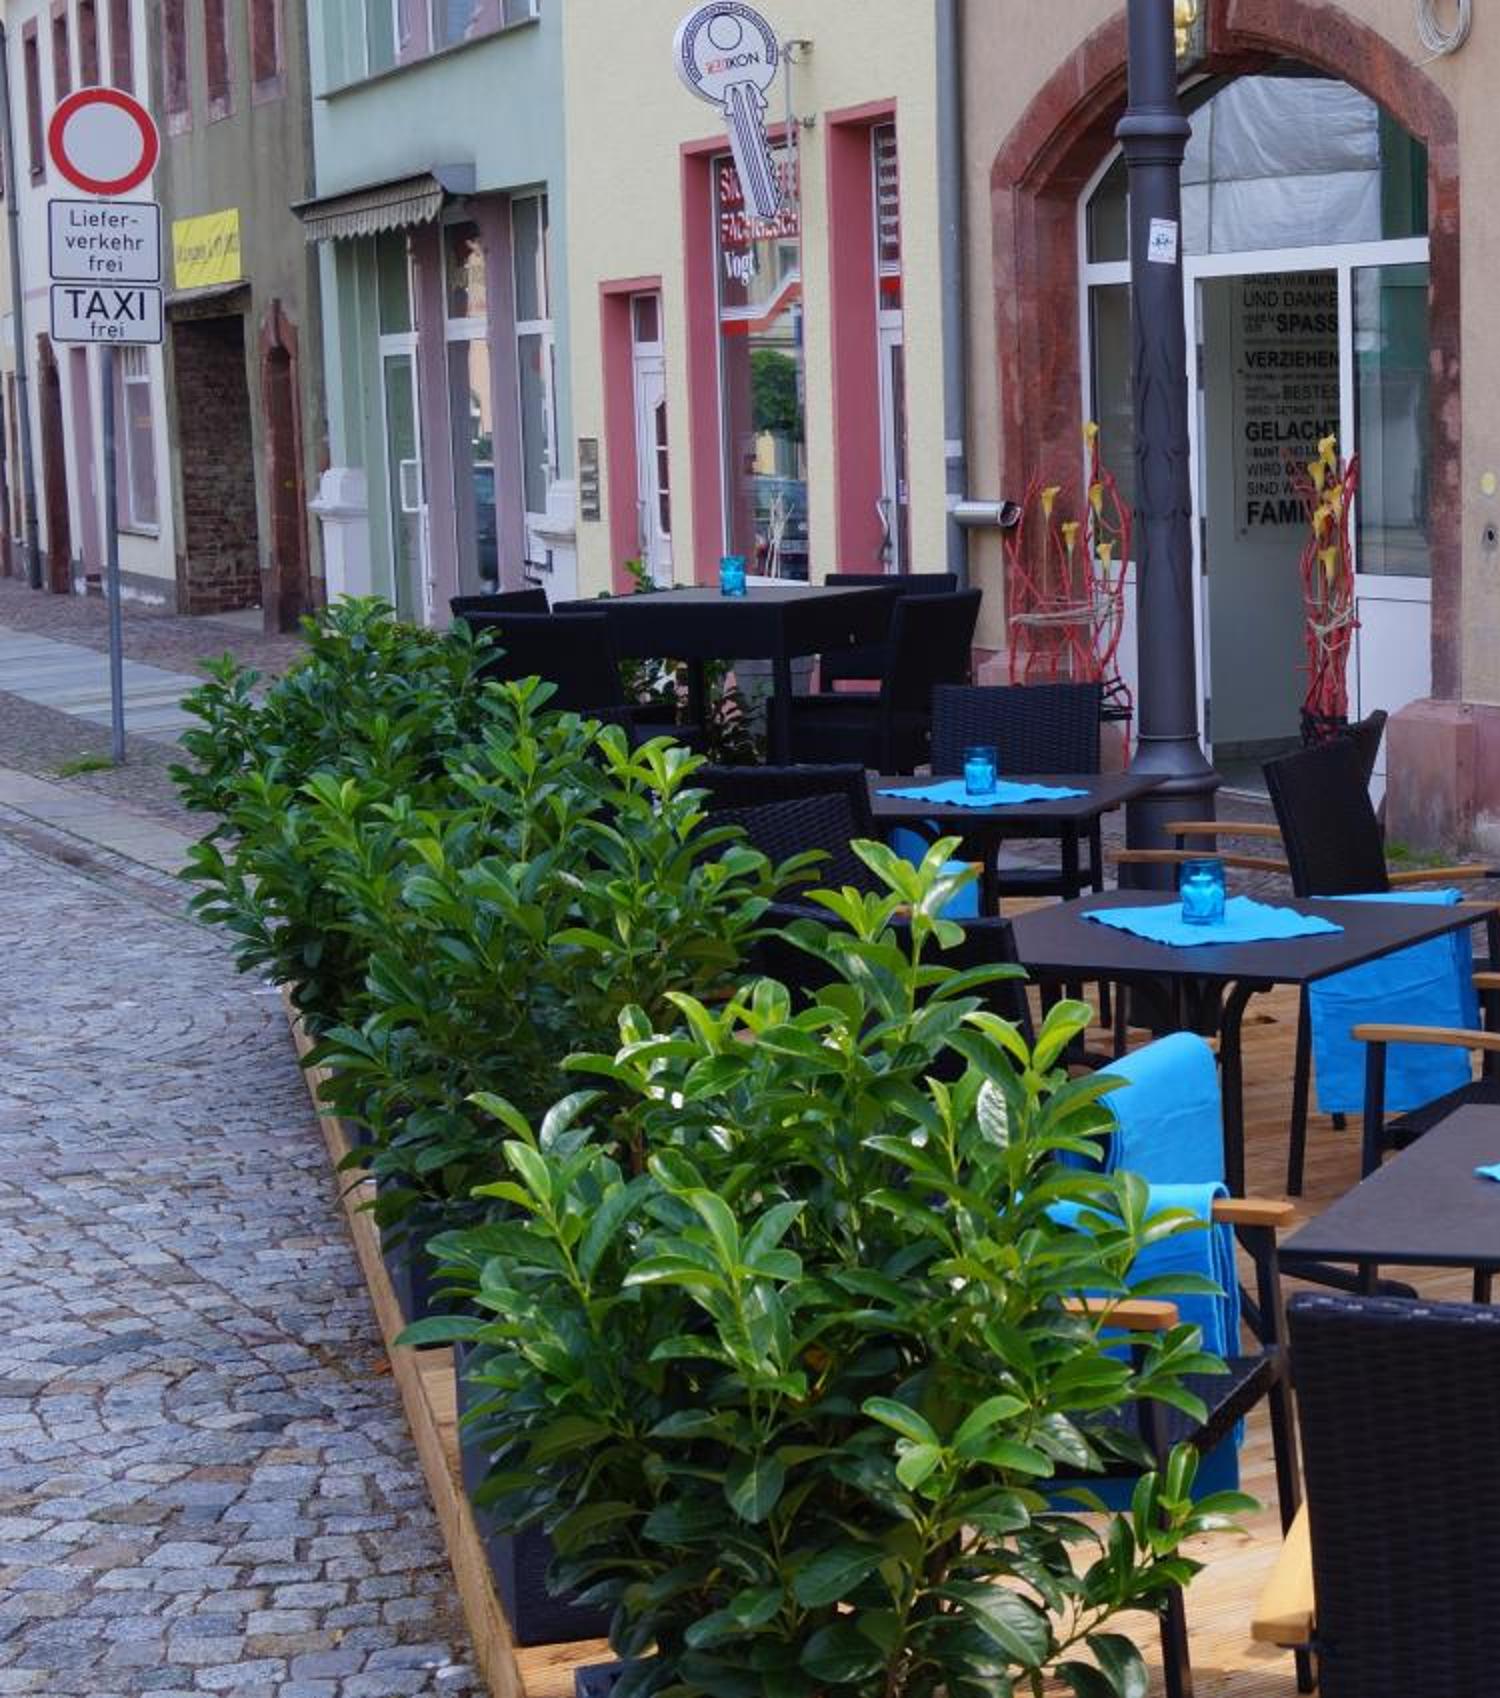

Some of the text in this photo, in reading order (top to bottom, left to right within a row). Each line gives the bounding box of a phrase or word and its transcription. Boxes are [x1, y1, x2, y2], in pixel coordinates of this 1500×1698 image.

[69, 209, 139, 228] Liefer-
[65, 234, 144, 251] verkehr
[88, 255, 123, 273] frei
[724, 250, 755, 286] Vogt
[64, 289, 145, 321] TAXI
[1243, 288, 1279, 307] UND
[91, 320, 125, 338] frei
[1277, 312, 1338, 334] SPASS
